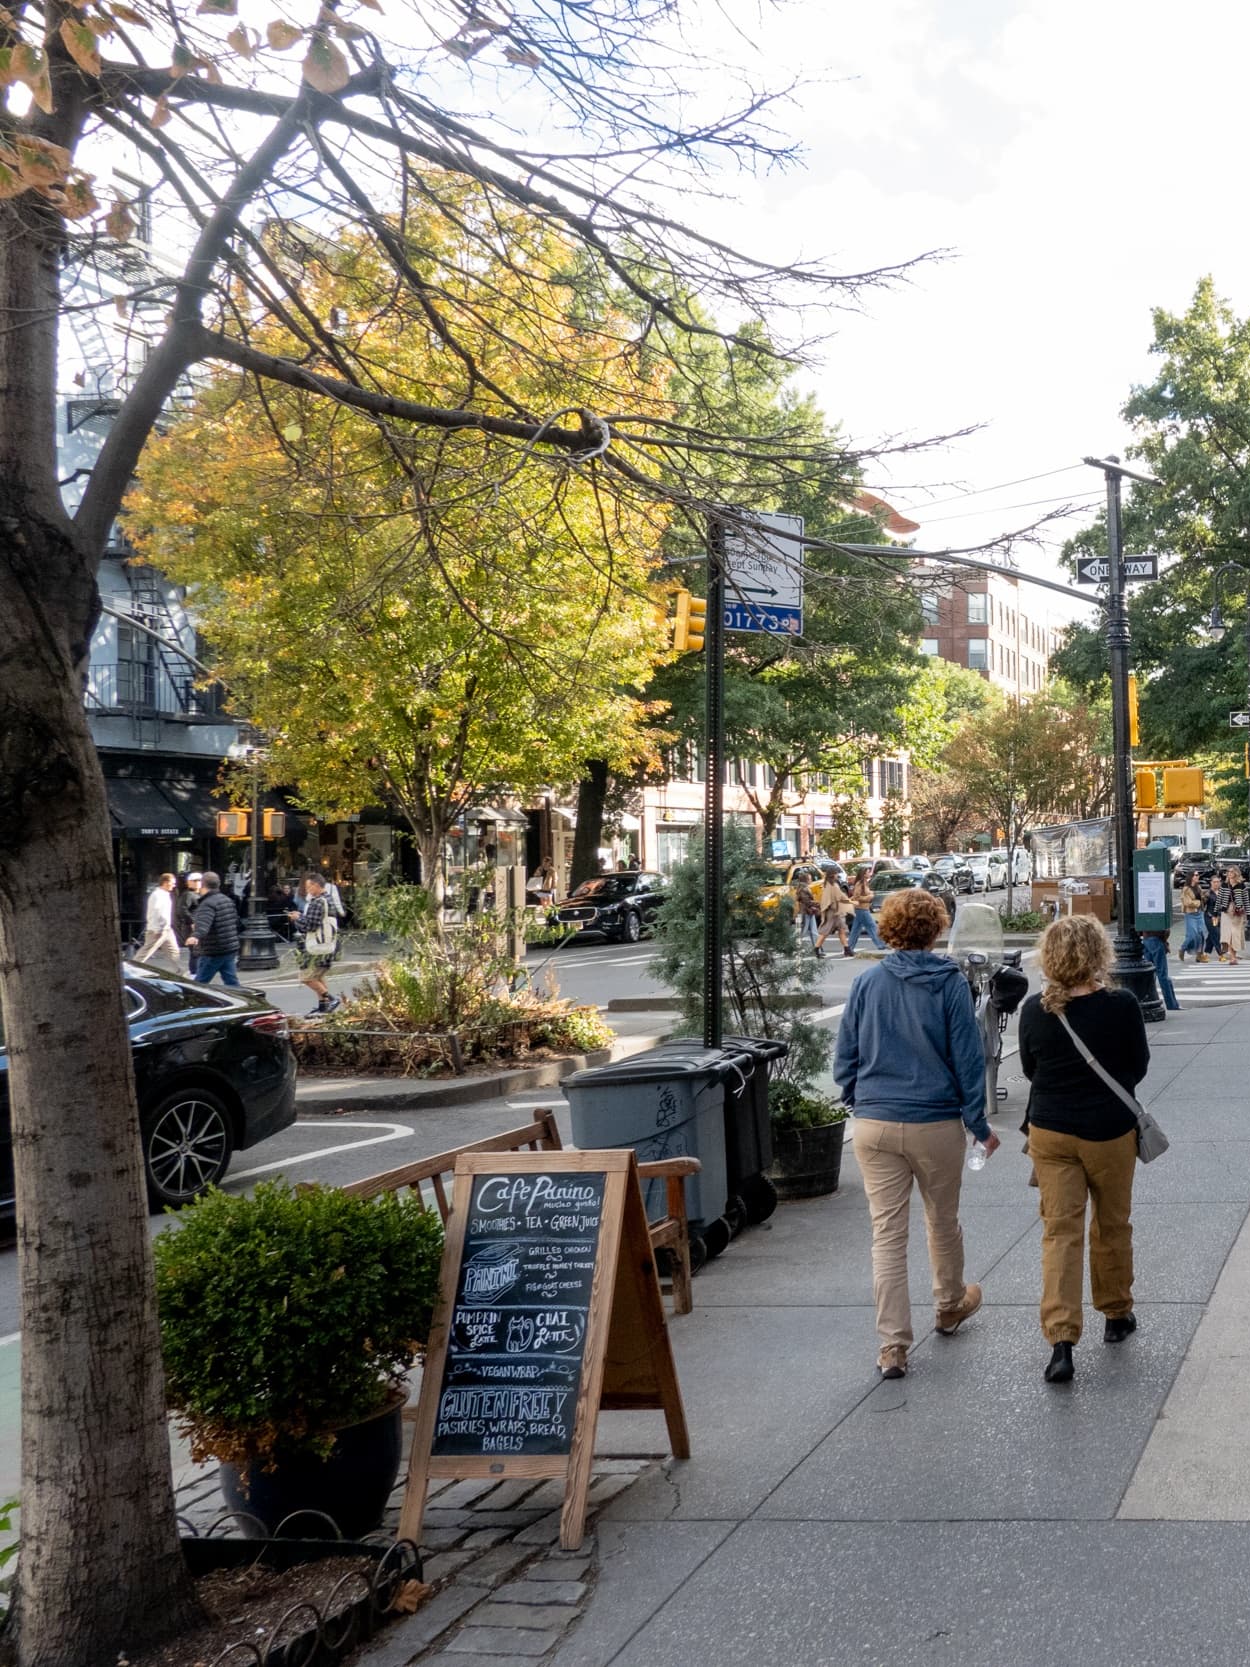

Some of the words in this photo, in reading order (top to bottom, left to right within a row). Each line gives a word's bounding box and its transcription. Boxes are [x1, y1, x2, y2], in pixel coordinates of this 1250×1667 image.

[1089, 564, 1110, 576] ONE
[1124, 563, 1147, 574] WAY
[476, 1176, 532, 1213] Cafe
[525, 1175, 594, 1216] Panino
[470, 1216, 516, 1235] SMOOTHIES
[526, 1216, 543, 1229] TEA
[550, 1214, 579, 1232] GREEN
[528, 1246, 562, 1256] GRILLED
[464, 1258, 521, 1293] PANINI
[455, 1311, 503, 1325] PUMPKIN
[535, 1312, 571, 1326] CHAI
[465, 1323, 496, 1336] SPICE
[480, 1365, 512, 1378] VEGAN
[511, 1365, 541, 1379] WRAP
[439, 1390, 509, 1421] GLUTEN
[482, 1435, 524, 1451] BAGELS
